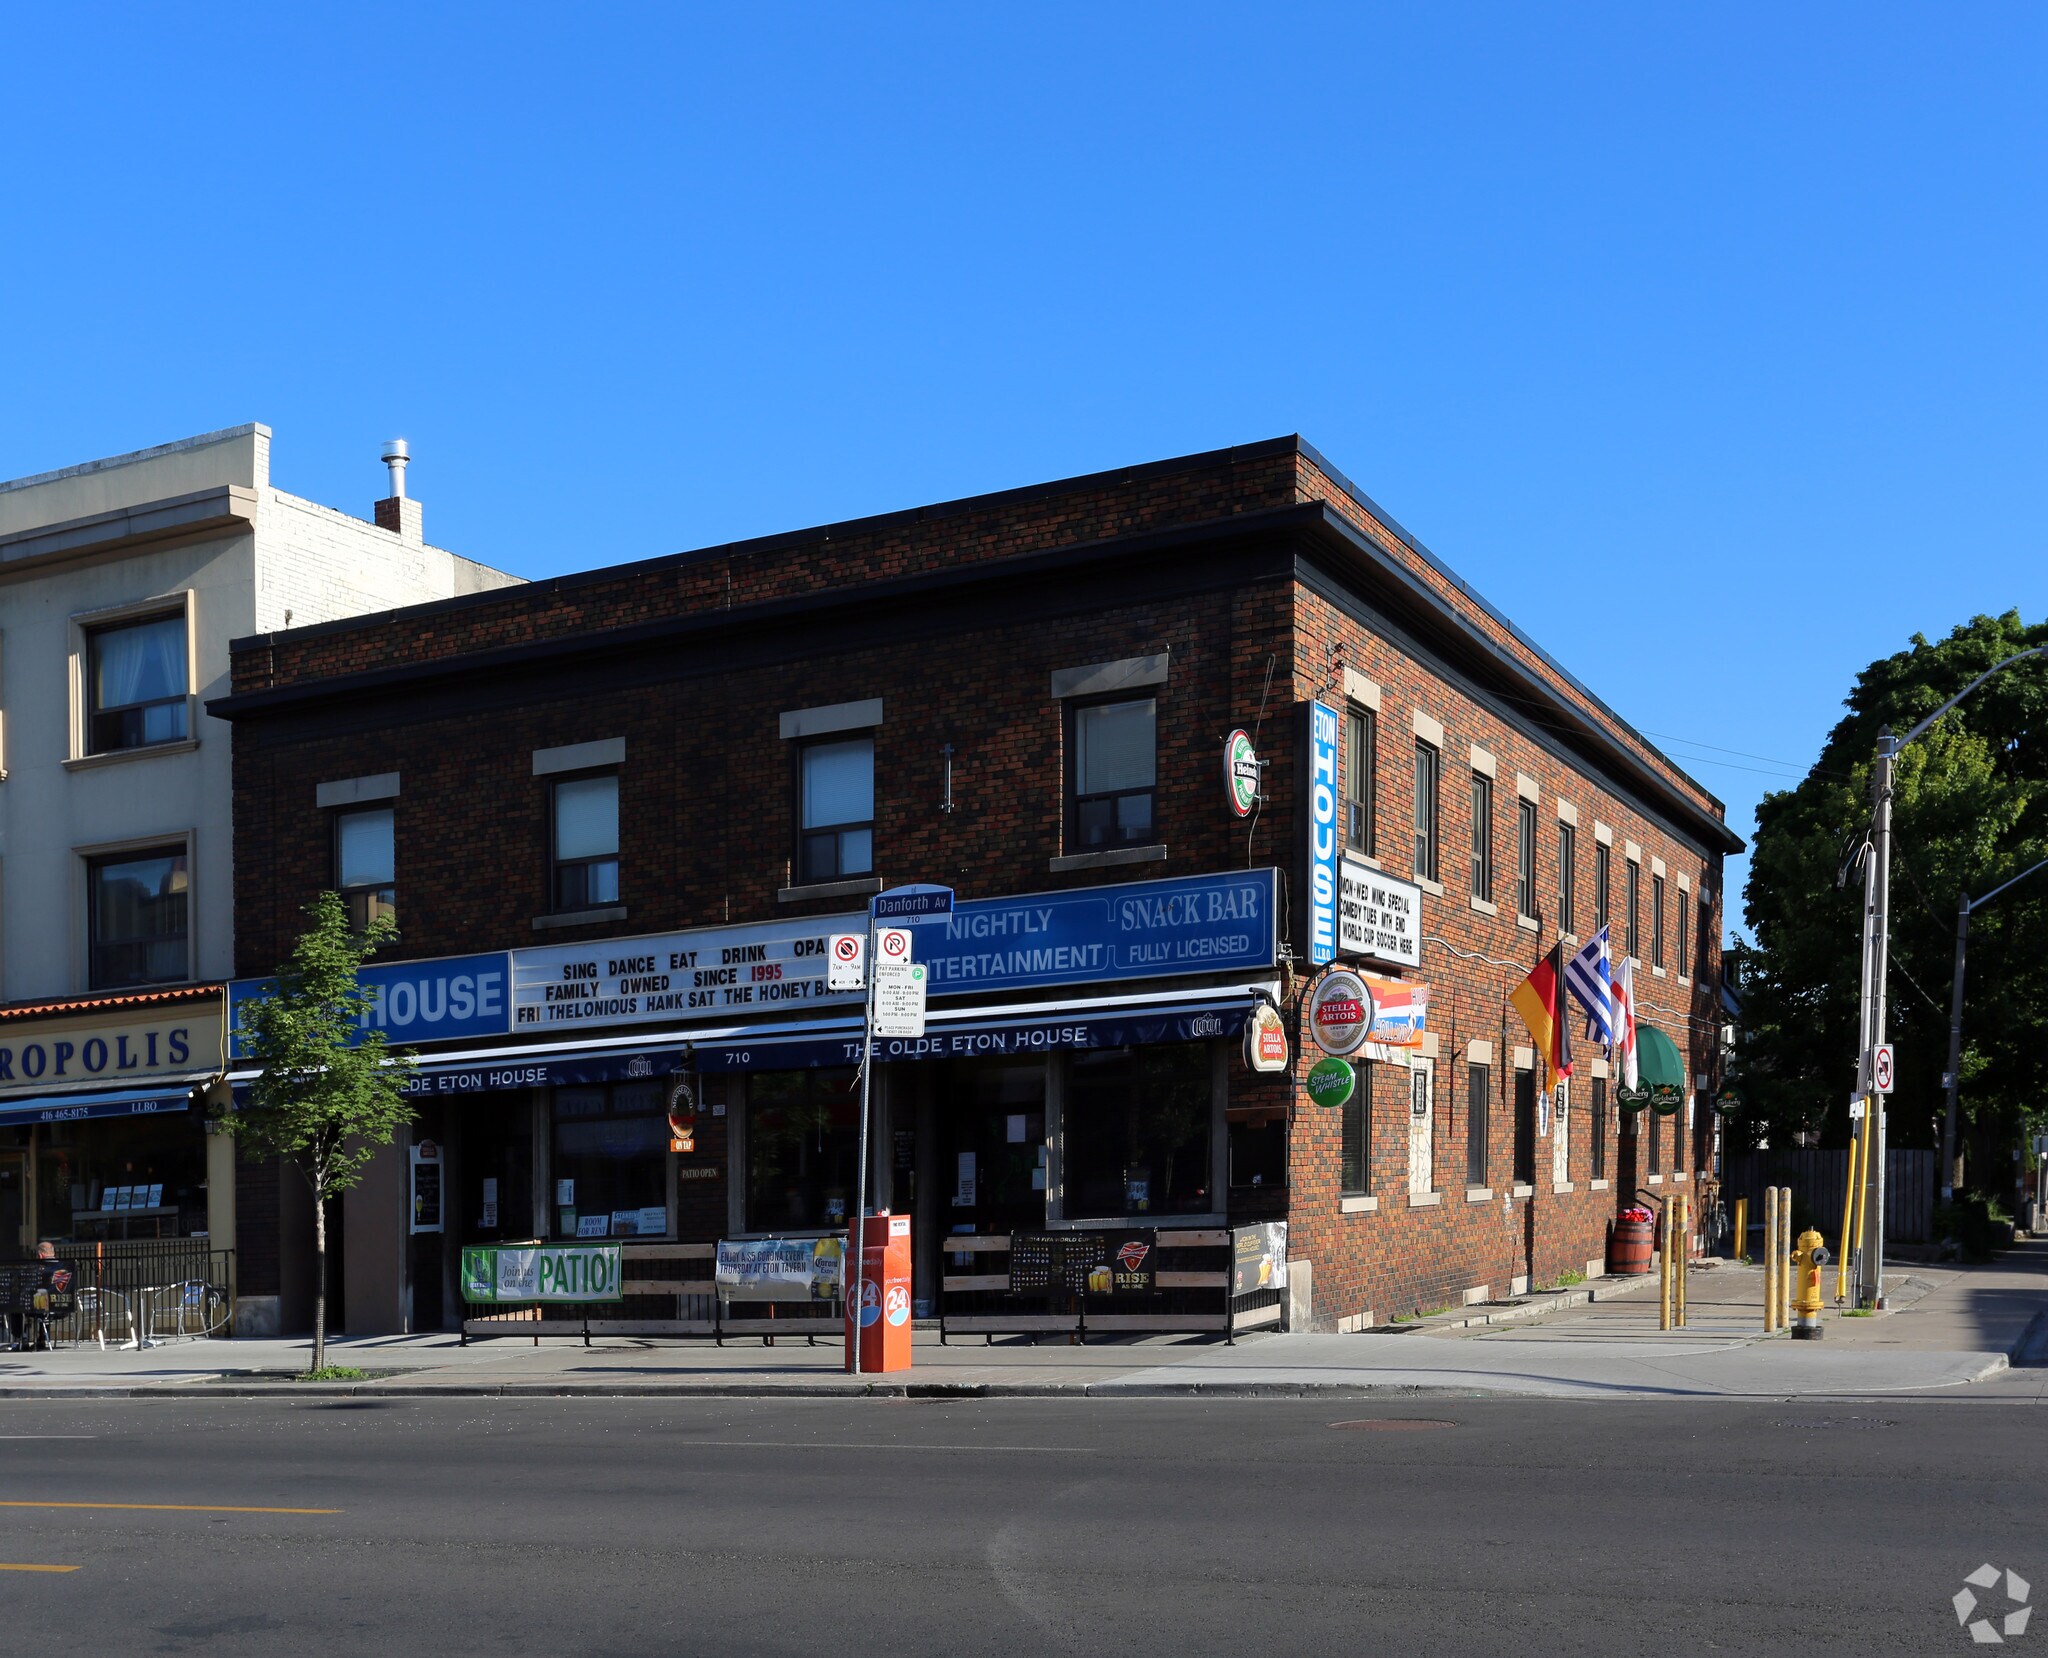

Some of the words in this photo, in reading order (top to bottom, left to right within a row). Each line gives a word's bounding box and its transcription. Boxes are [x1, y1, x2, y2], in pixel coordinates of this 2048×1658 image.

[1314, 709, 1335, 747] ETON
[1314, 741, 1334, 946] HOUSE
[880, 896, 929, 913] Danforth
[934, 897, 946, 908] Av
[1371, 887, 1386, 907] WING
[1388, 893, 1410, 915] SPECIAL
[1121, 894, 1201, 931] SNACK
[1207, 887, 1258, 923] BAR
[1340, 898, 1362, 920] COMEDY
[1363, 906, 1377, 925] TUES
[1395, 916, 1406, 933] END
[906, 916, 920, 924] 710
[946, 908, 1053, 941] NIGHTLY
[1342, 921, 1362, 942] WORLD
[1364, 928, 1375, 945] CUP
[1376, 931, 1397, 950] SOCCER
[1399, 937, 1413, 955] HERE
[1129, 942, 1172, 963] FULLY
[1176, 934, 1250, 958] LICENSED
[563, 962, 597, 980] SING
[609, 956, 655, 976] DANCE
[670, 952, 697, 970] EAT
[722, 945, 766, 965] DRINK
[793, 938, 826, 957] OPA
[545, 981, 600, 1001] FAMILY
[620, 975, 670, 995] OWNED
[694, 968, 737, 987] SINCE
[751, 963, 783, 982] 1995
[360, 972, 501, 1028] HOUSE
[517, 1007, 540, 1023] FRI
[548, 998, 637, 1020] THELONIOUS
[646, 993, 683, 1012] HANK
[688, 990, 716, 1007] SAT
[724, 986, 753, 1005] THE
[759, 981, 811, 1001] HONEY
[1321, 1003, 1357, 1013] STELLA
[1321, 1012, 1357, 1022] ARTOIS
[1192, 1014, 1224, 1037] COOL
[843, 1041, 882, 1058] THE
[889, 1037, 943, 1055] OLDE
[952, 1033, 1006, 1051] ETON
[1015, 1026, 1088, 1047] HOUSE
[1262, 1033, 1281, 1043] STELLA
[0, 1028, 190, 1081] ROPOLIS
[1263, 1044, 1283, 1054] ARTOIS
[725, 1052, 751, 1065] 710
[438, 1073, 482, 1090] ETON
[489, 1067, 548, 1086] HOUSE
[1311, 1072, 1338, 1087] STEAM
[1315, 1075, 1351, 1095] WHISTLE
[1619, 1088, 1649, 1099] Carlsberg
[1651, 1092, 1680, 1103] Carlsberg
[1716, 1097, 1741, 1107] Carlsberg
[40, 1110, 53, 1121] 416
[54, 1107, 89, 1119] 465-8175
[675, 1141, 683, 1150] ON
[683, 1141, 692, 1150] TAP
[682, 1169, 700, 1179] PATIO
[700, 1168, 717, 1178] OPEN
[584, 1217, 602, 1226] ROOM
[578, 1226, 590, 1236] FOR
[591, 1226, 606, 1235] RENT
[720, 1251, 739, 1262] ENJOY
[741, 1251, 746, 1261] A
[747, 1251, 756, 1262] $5
[757, 1250, 784, 1261] CORONA
[785, 1250, 805, 1261] EVERY
[502, 1264, 521, 1278] Join
[523, 1268, 534, 1277] us
[539, 1253, 615, 1294] PATIO!
[720, 1263, 752, 1275] THURSDAY
[753, 1263, 761, 1274] AT
[762, 1262, 780, 1274] ETON
[781, 1262, 807, 1273] TAVERN
[504, 1279, 516, 1288] on
[518, 1276, 533, 1288] the
[1114, 1272, 1150, 1284] RISE
[50, 1293, 73, 1303] RISE
[888, 1289, 908, 1311] 24
